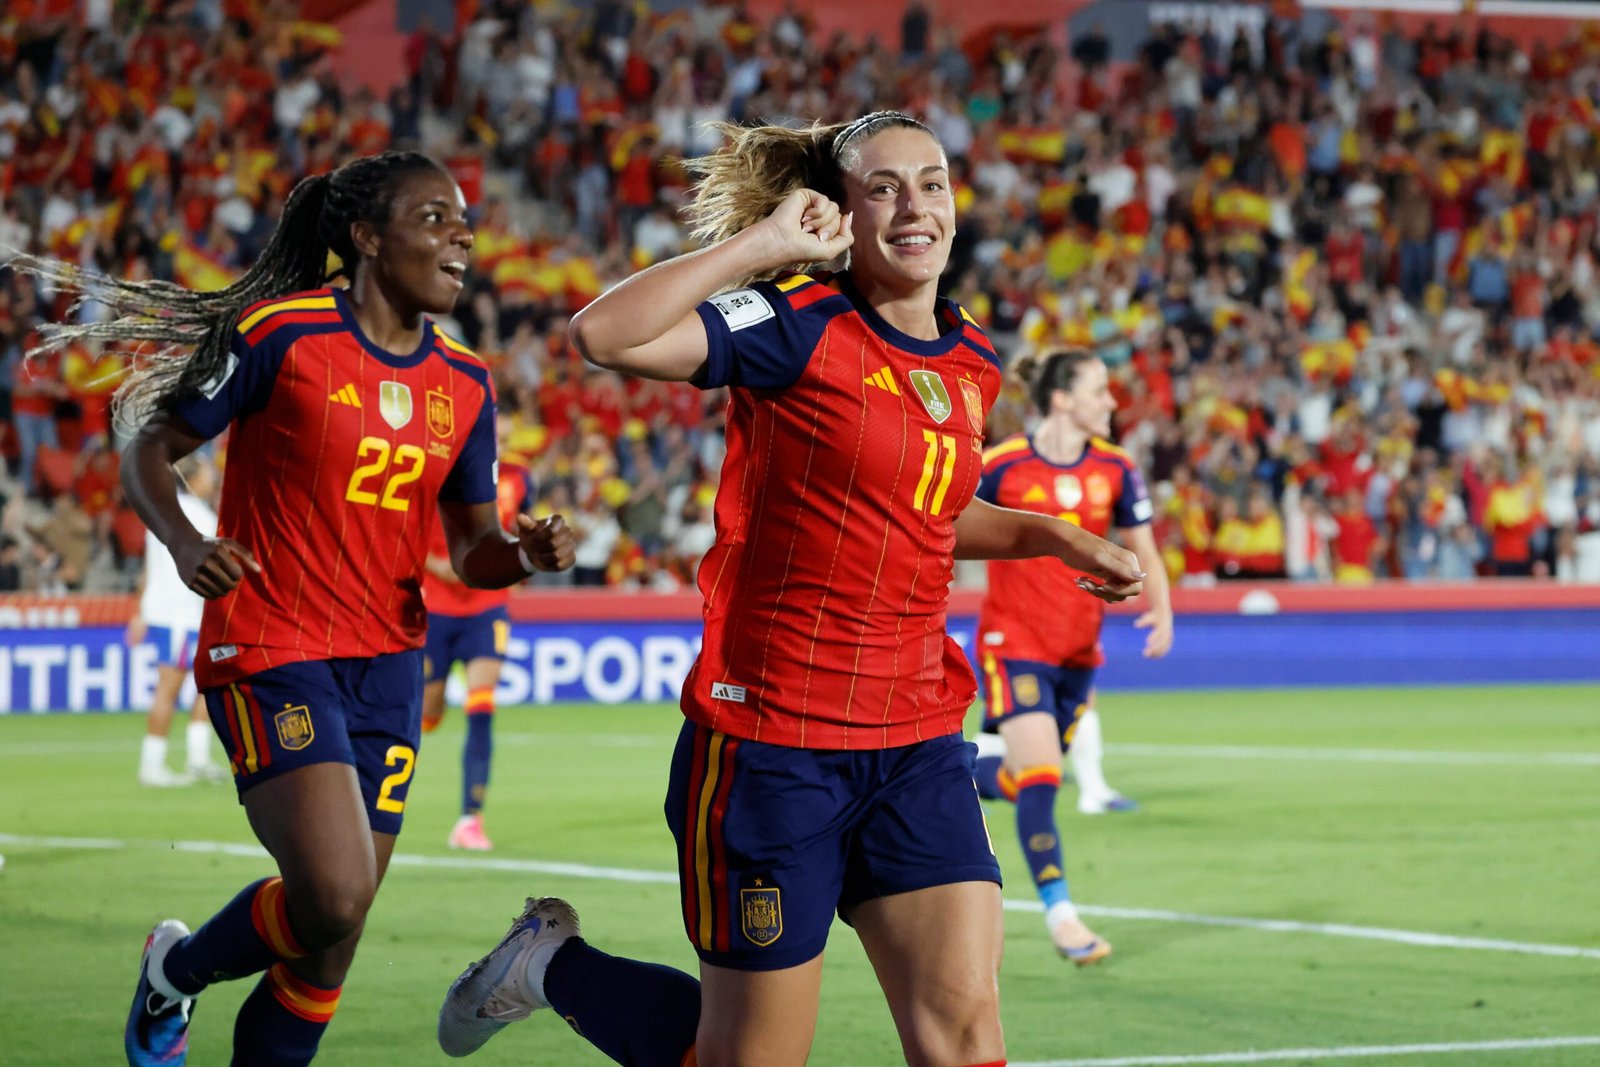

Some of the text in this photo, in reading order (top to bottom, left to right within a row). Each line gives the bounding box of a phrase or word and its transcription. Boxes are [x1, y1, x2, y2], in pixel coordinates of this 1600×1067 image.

[345, 436, 426, 512] 22
[913, 428, 957, 516] 11
[494, 633, 703, 705] SPOR
